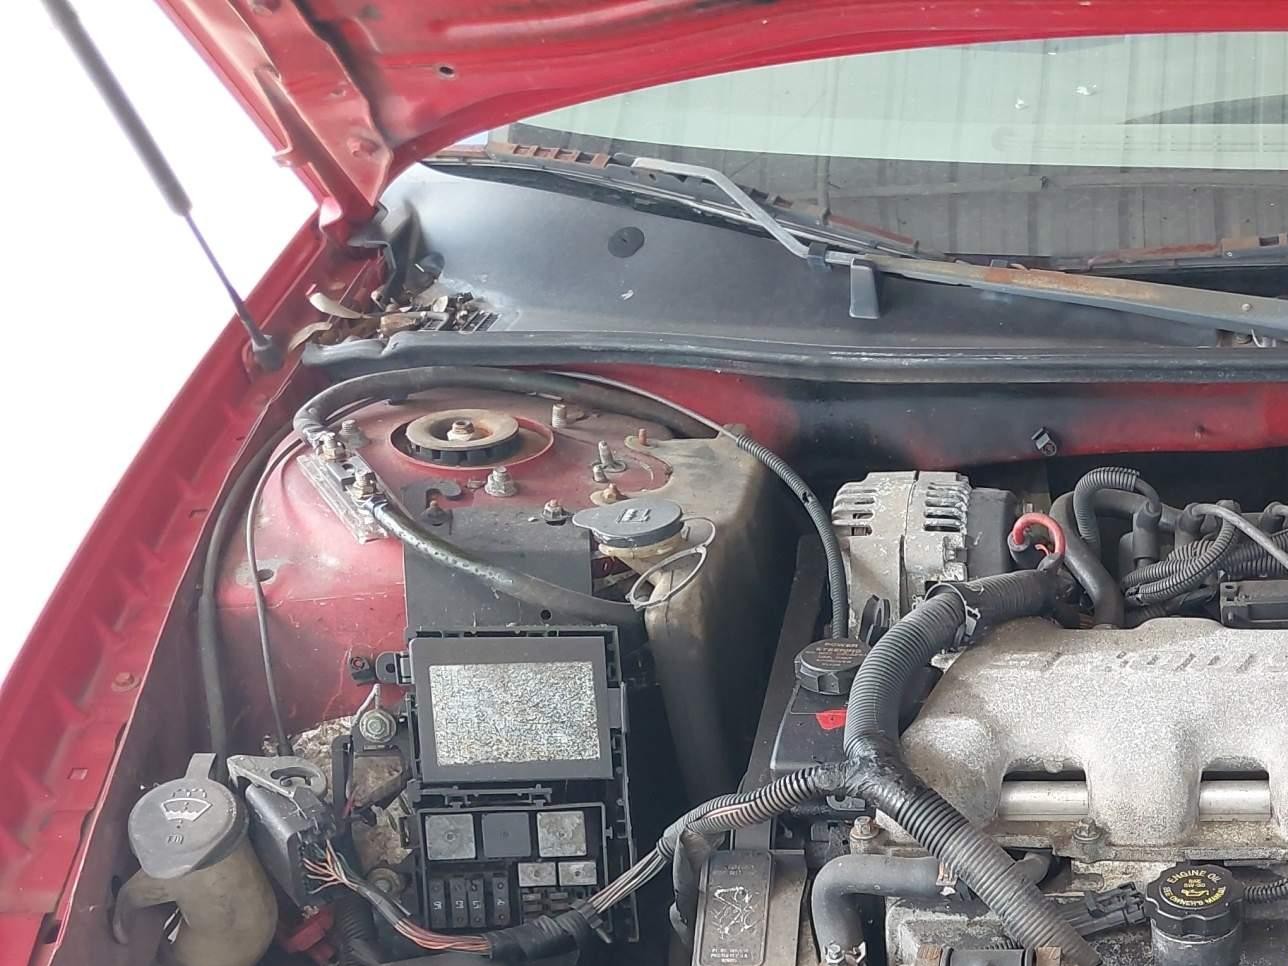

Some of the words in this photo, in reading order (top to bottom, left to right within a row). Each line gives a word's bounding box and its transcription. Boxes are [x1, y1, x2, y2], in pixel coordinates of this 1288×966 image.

[1166, 869, 1206, 884] ENGINE
[1207, 873, 1221, 883] OIL
[1204, 886, 1227, 904] MANUAL
